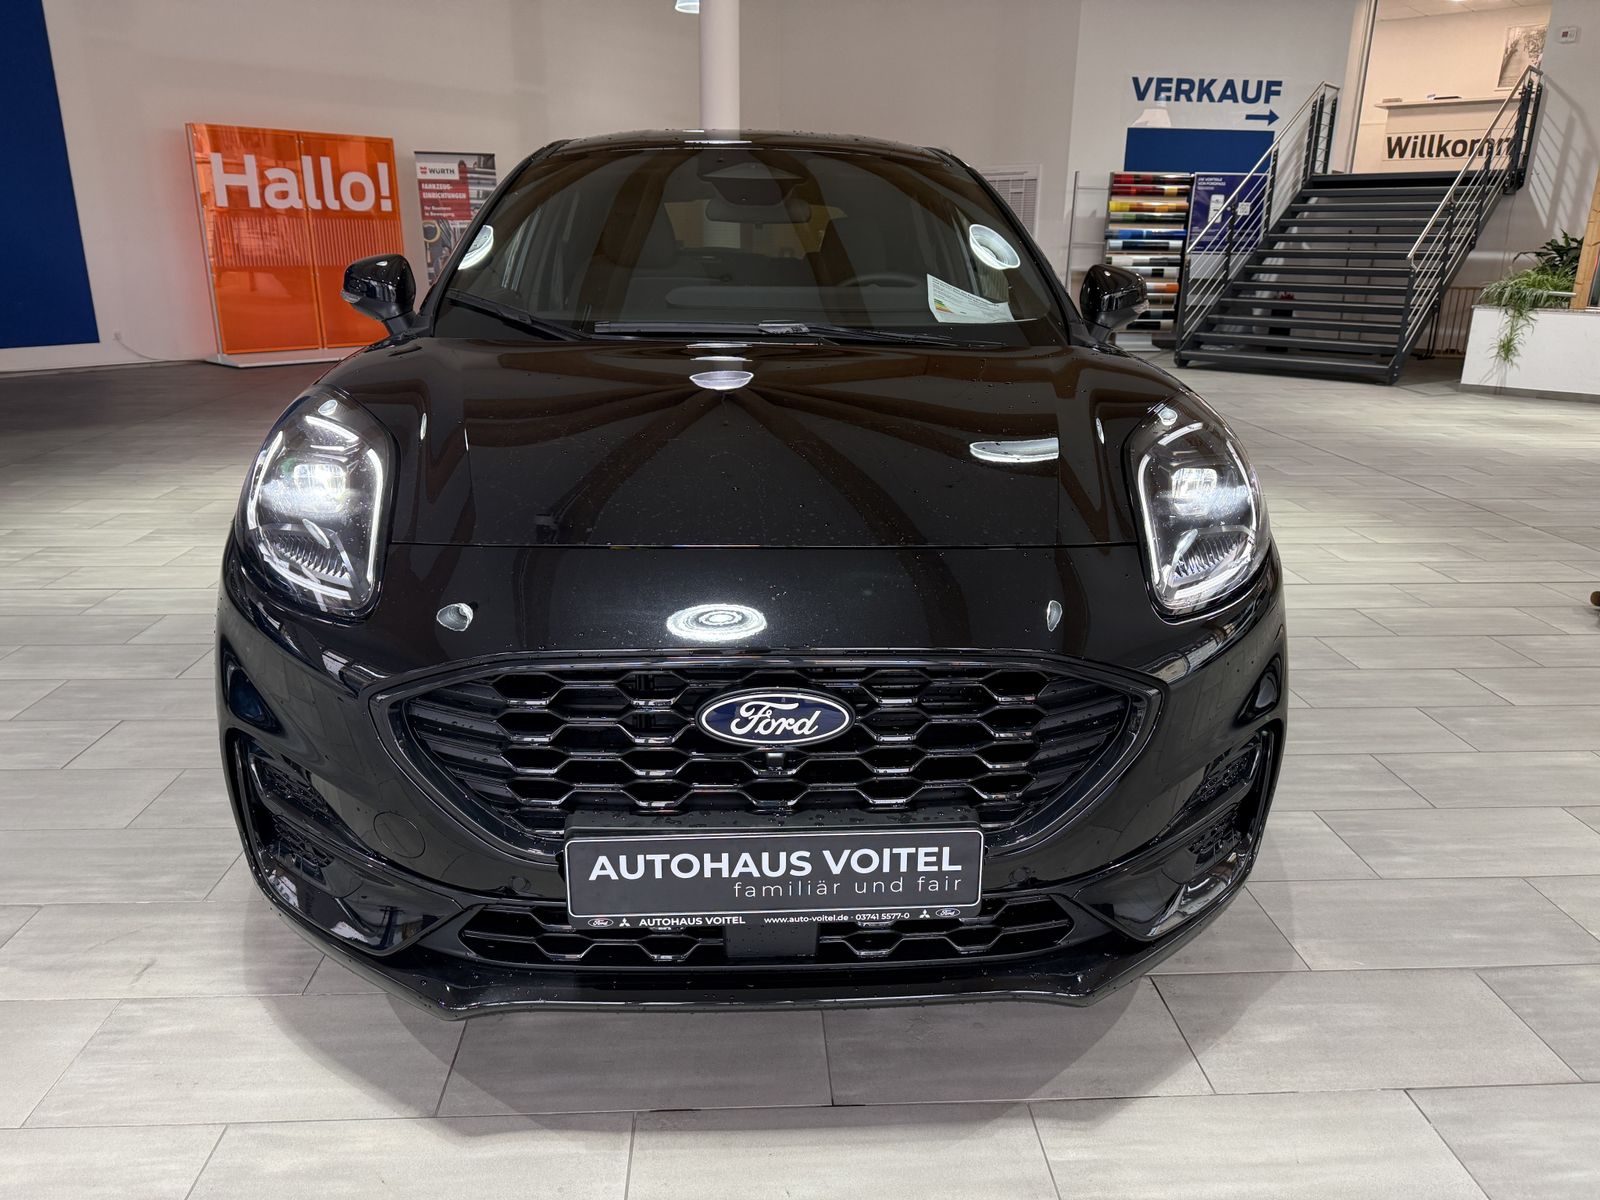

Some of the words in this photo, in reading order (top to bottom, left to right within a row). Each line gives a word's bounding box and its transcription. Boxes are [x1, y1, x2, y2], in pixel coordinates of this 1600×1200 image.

[1131, 76, 1283, 104] VERKAUF
[210, 152, 393, 212] Hallo!
[428, 167, 455, 175] WÜRTH
[730, 701, 821, 735] Ford
[588, 850, 813, 881] AUTOHAUS
[822, 846, 963, 875] VOITEL
[733, 880, 841, 898] familiär
[854, 877, 904, 894] und
[917, 875, 963, 892] fair
[638, 917, 703, 927] AUTOHAUS
[705, 916, 746, 925] VOITEL
[764, 913, 849, 925] www.auto-voitel.de
[855, 913, 880, 922] 03741
[881, 912, 910, 921] 5577-0
